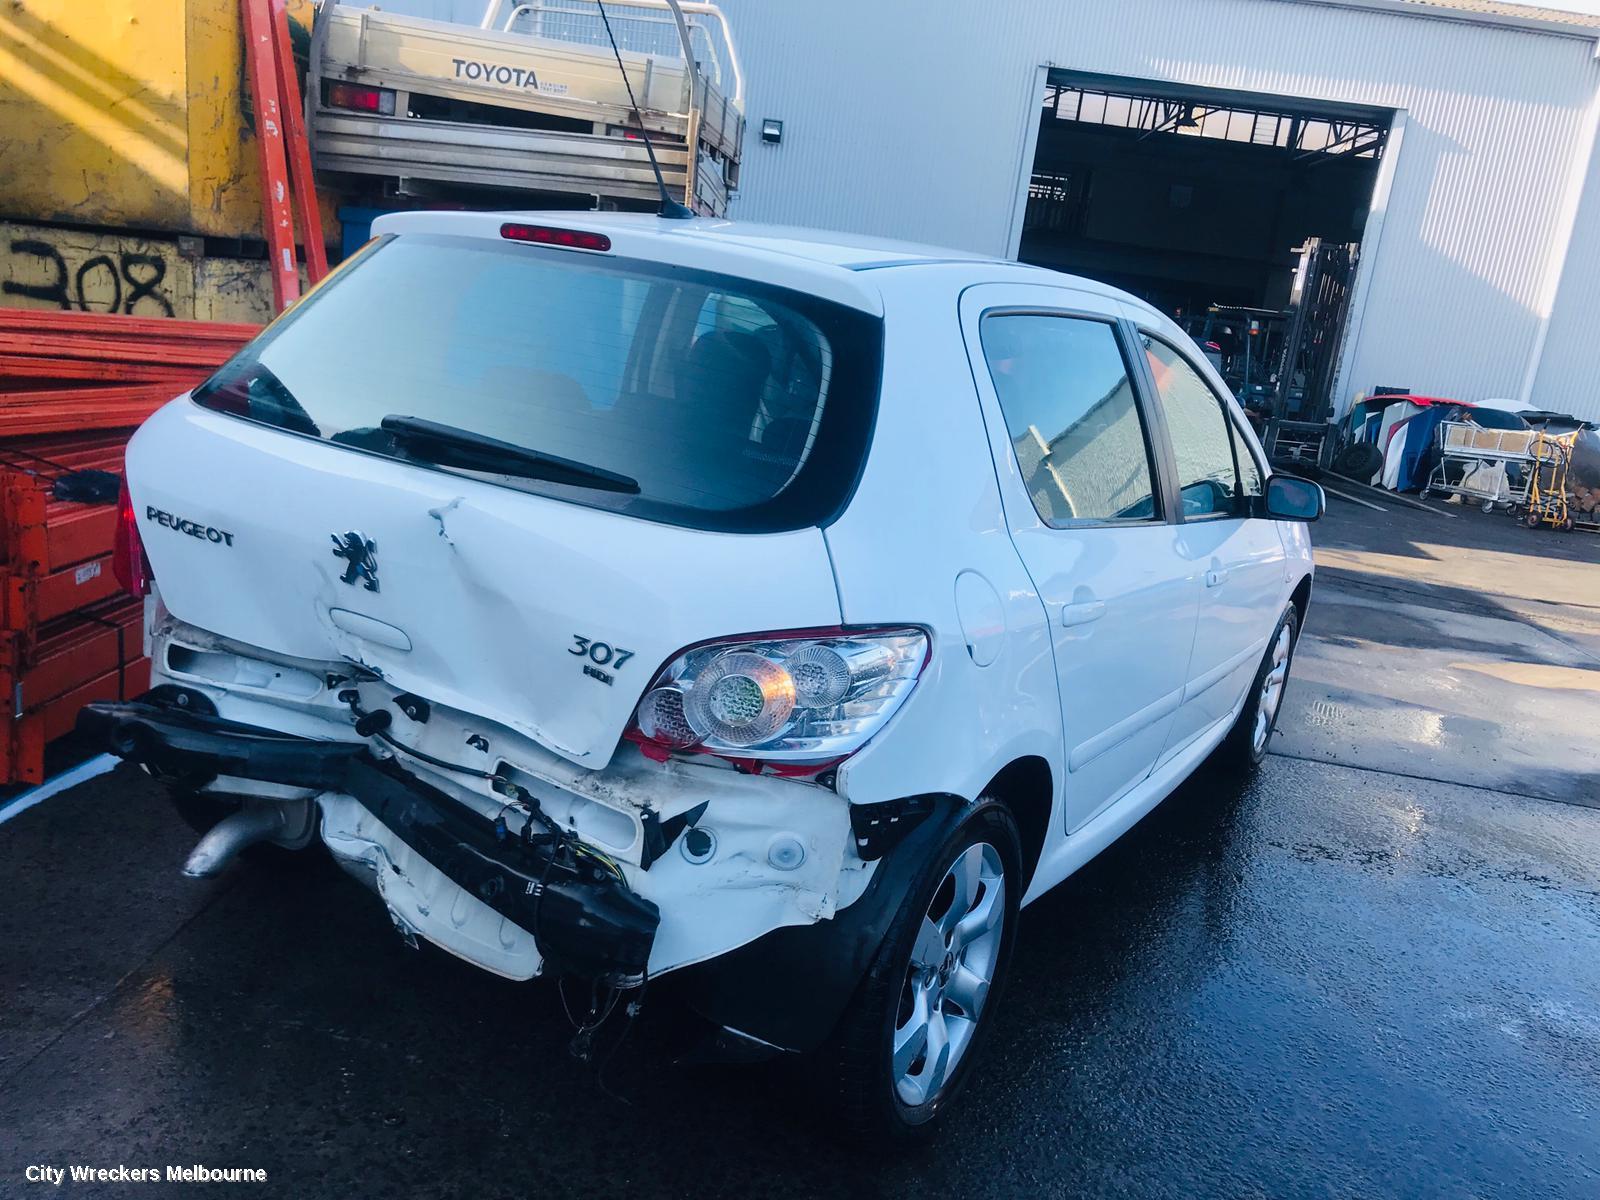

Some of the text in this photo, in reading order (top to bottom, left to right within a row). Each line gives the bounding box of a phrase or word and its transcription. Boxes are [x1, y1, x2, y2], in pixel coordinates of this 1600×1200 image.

[452, 58, 539, 89] TOYOTA
[146, 505, 235, 548] PEUGEOT
[567, 633, 635, 671] 307
